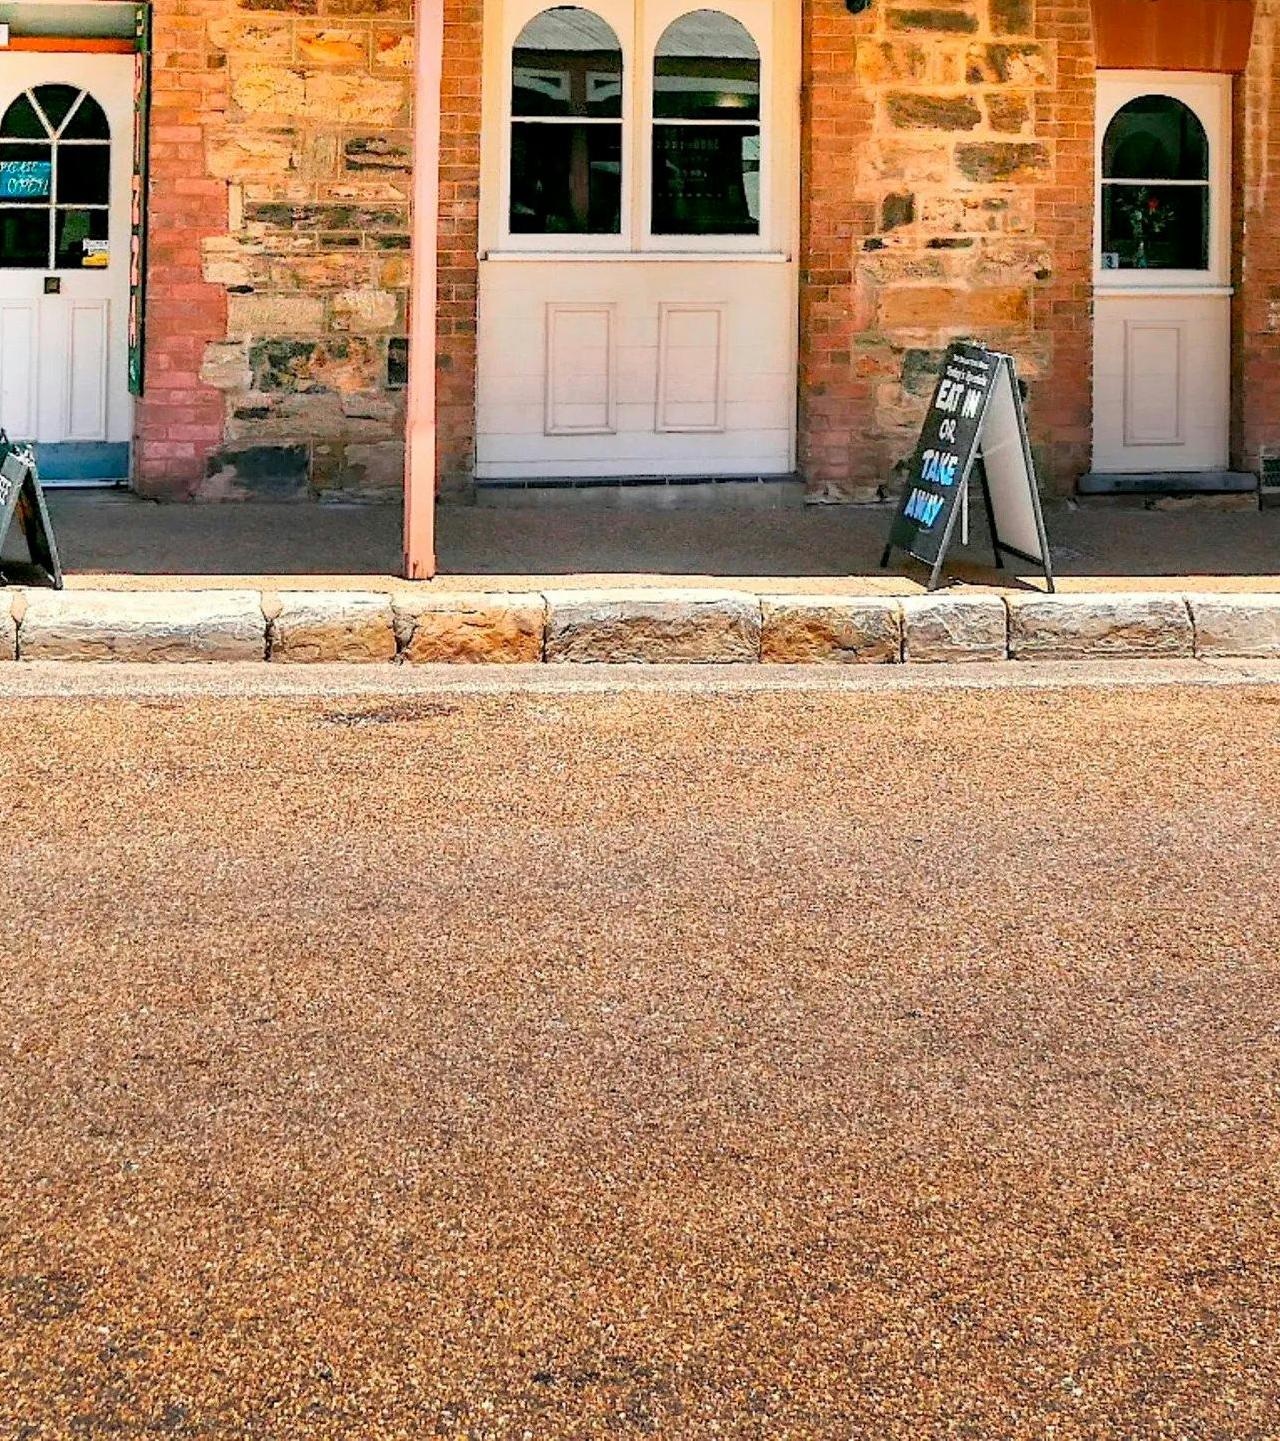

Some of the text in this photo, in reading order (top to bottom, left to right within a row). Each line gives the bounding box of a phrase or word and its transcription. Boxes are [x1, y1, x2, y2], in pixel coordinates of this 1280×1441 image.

[935, 378, 981, 418] EAT IN
[939, 418, 957, 444] OR
[921, 448, 958, 486] TAKE
[903, 487, 945, 528] AWAY
